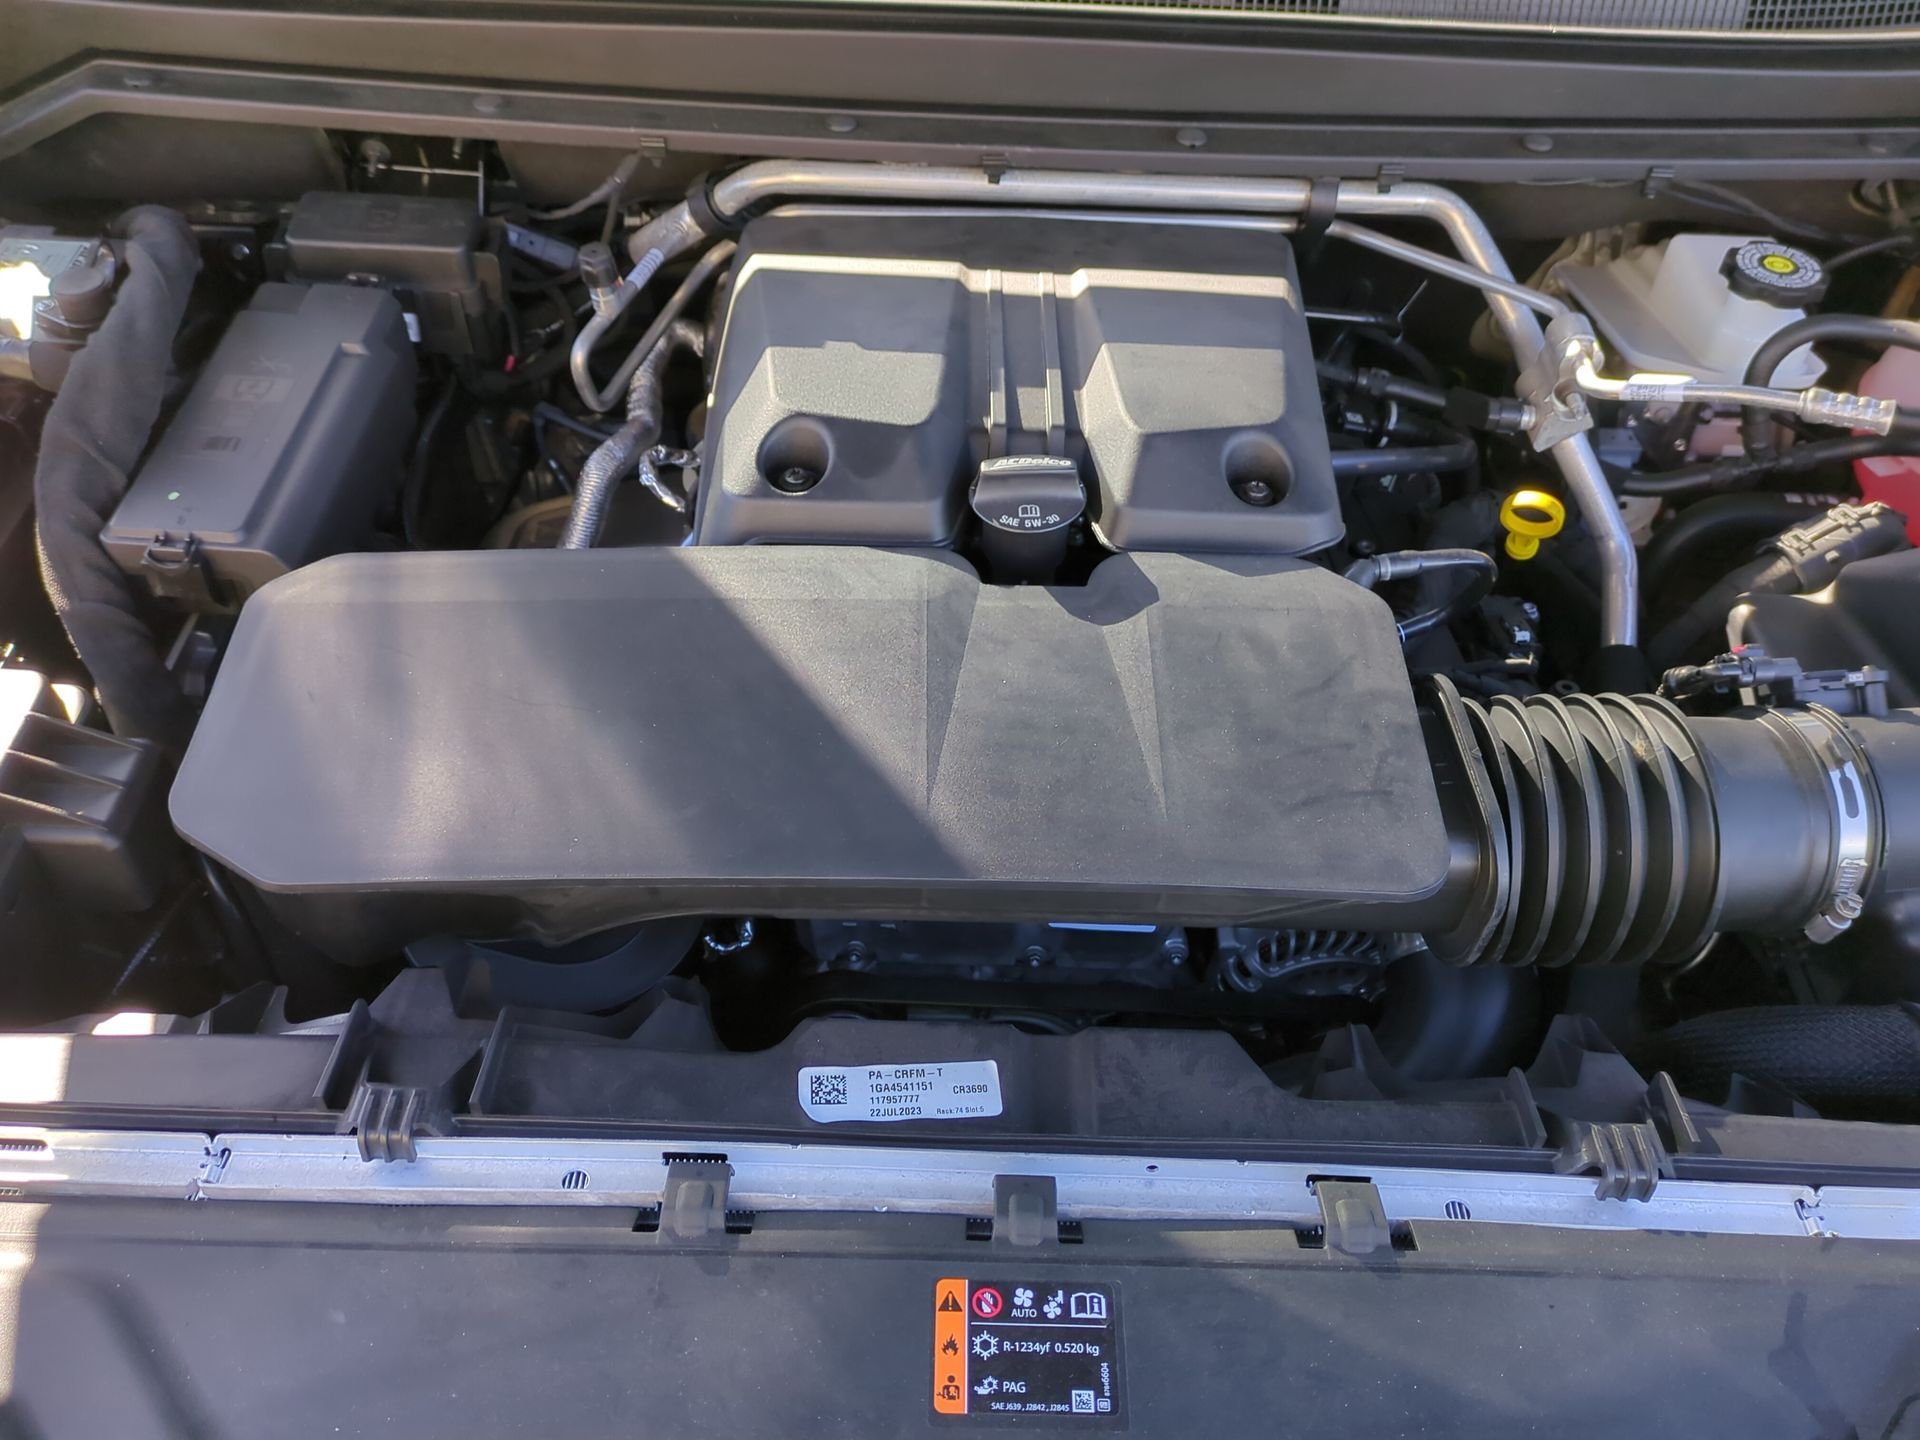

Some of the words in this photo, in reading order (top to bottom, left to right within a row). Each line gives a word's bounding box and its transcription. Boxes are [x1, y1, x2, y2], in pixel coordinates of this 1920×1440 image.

[992, 457, 1072, 468] ACDelco
[999, 514, 1020, 528] SAE
[1024, 514, 1060, 528] 5W-30
[869, 1081, 933, 1093] 1GA4541151
[952, 1084, 988, 1095] CR3690
[869, 1094, 920, 1105] 117957777
[869, 1106, 922, 1118] 22JUL2023
[1011, 1308, 1037, 1318] AUTO
[1003, 1341, 1051, 1355] R-1234yf
[1054, 1342, 1084, 1354] 0.520
[1086, 1343, 1100, 1356] kg
[1002, 1381, 1026, 1393] PAG
[991, 1402, 1005, 1410] SAE
